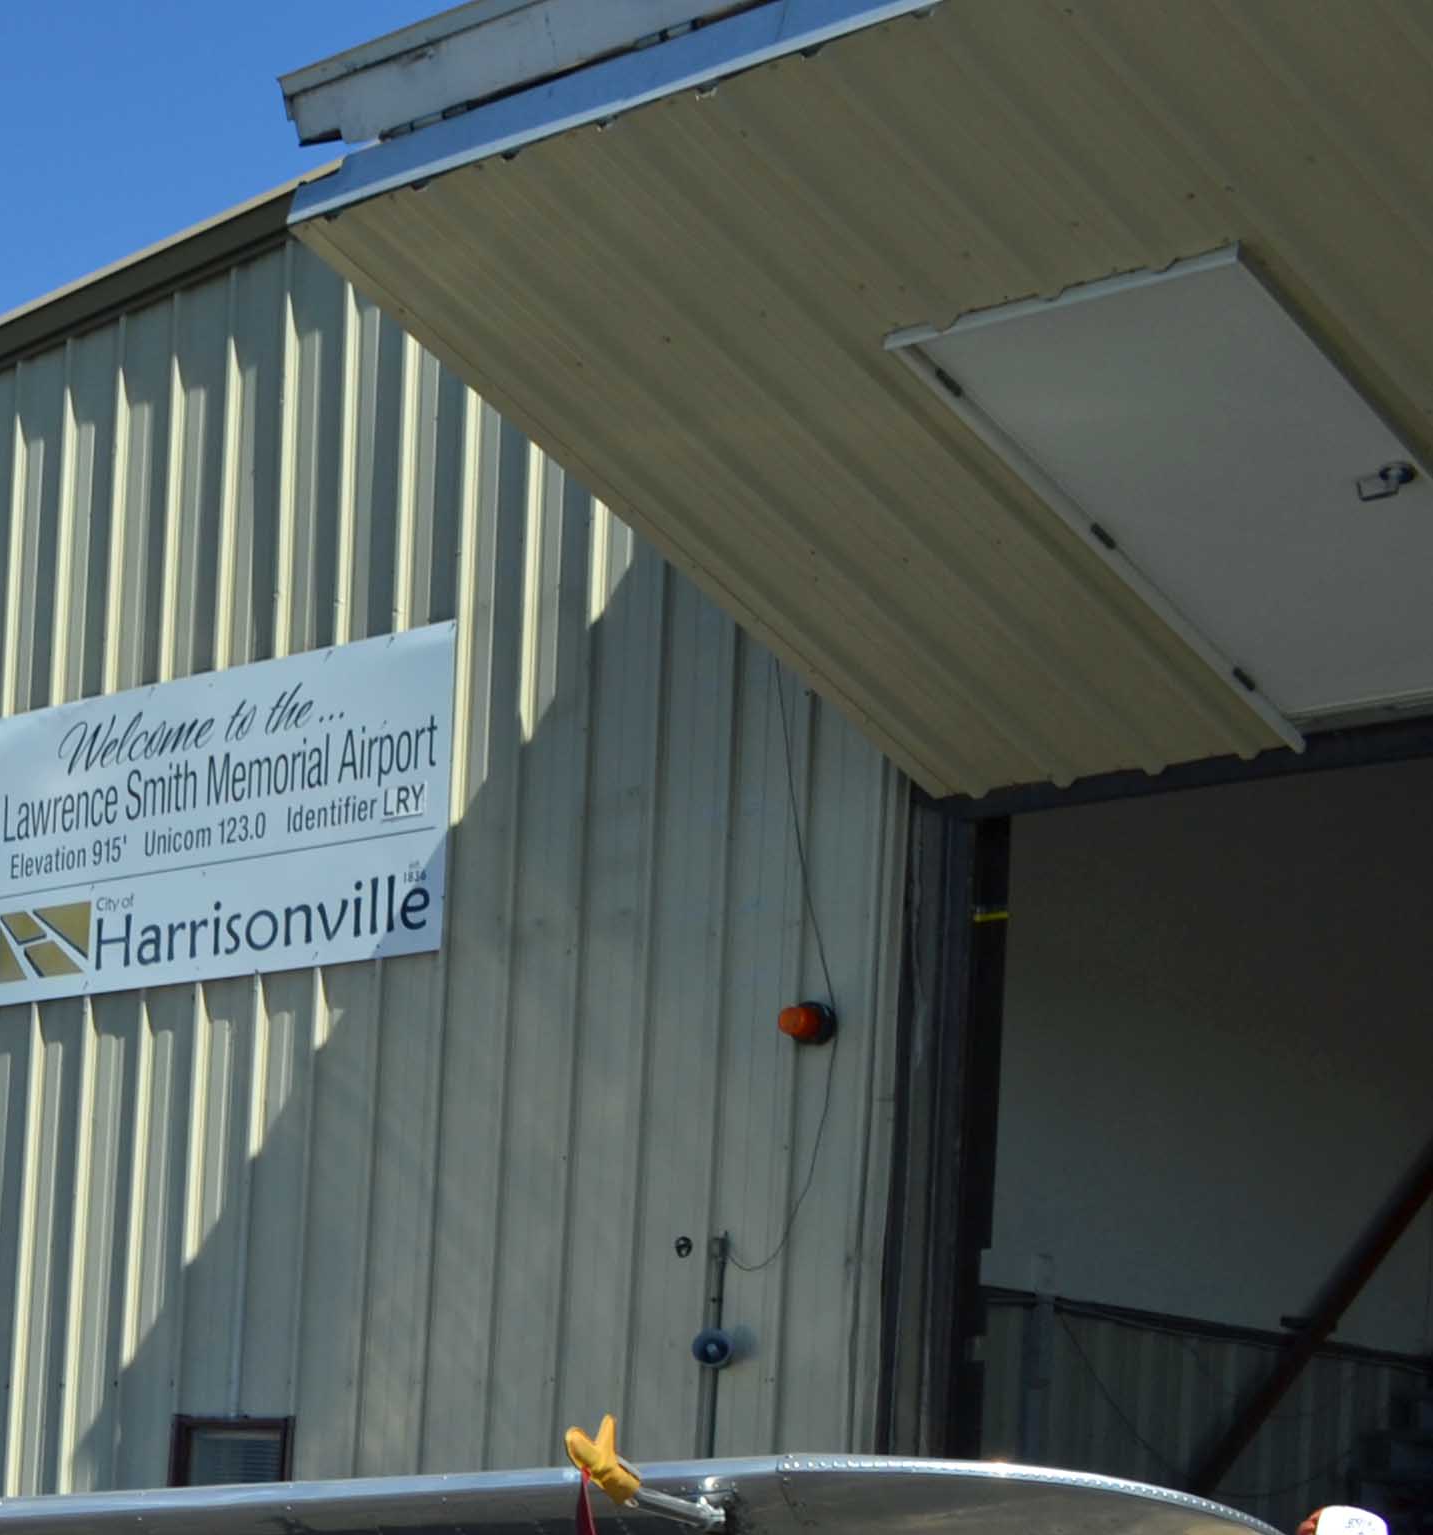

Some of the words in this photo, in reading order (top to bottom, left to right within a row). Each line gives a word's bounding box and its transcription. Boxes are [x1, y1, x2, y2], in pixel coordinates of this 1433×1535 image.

[3, 785, 119, 843] Lawrence
[125, 758, 197, 821] Smith
[207, 732, 330, 808] Memorial
[337, 714, 438, 787] Airport
[57, 710, 215, 776] Welcome
[223, 699, 258, 743] to
[9, 843, 87, 880] Elevation
[91, 834, 128, 867] 915'
[144, 826, 212, 857] Unicom
[218, 812, 267, 845] 123.0
[287, 795, 378, 833] Identifier
[383, 783, 425, 817] LRY
[95, 874, 430, 971] Harrisonville
[96, 897, 120, 912] City
[121, 894, 135, 908] of
